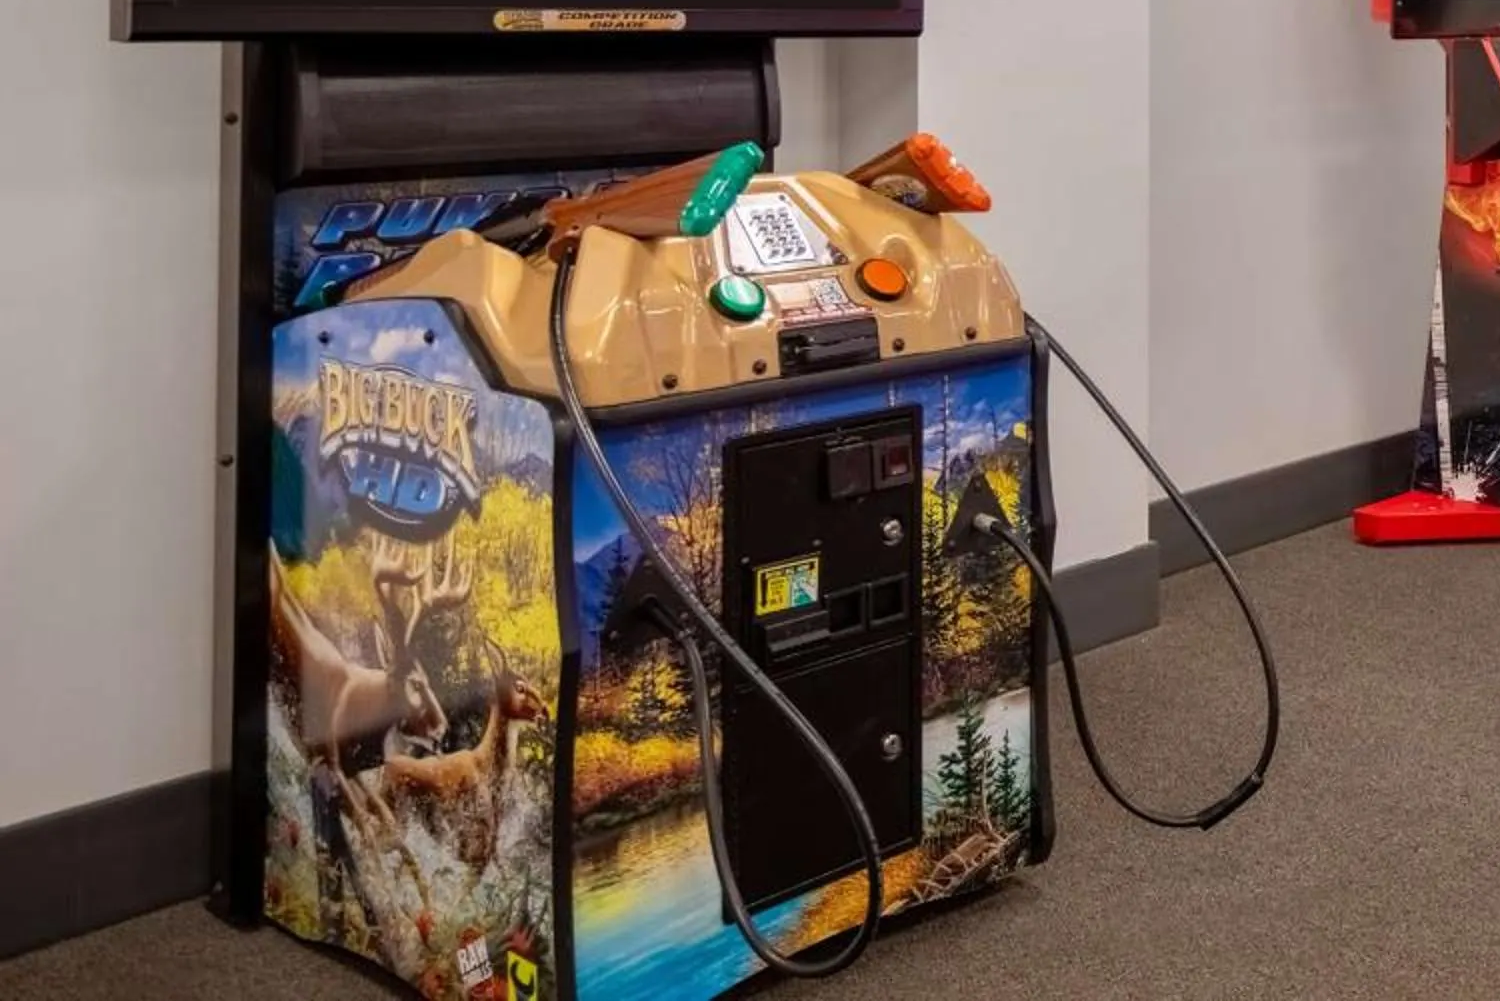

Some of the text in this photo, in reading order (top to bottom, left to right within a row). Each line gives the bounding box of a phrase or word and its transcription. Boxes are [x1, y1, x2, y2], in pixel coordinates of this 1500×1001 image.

[558, 10, 678, 21] COMPETITION
[348, 449, 446, 514] HD
[456, 935, 489, 975] RAW
